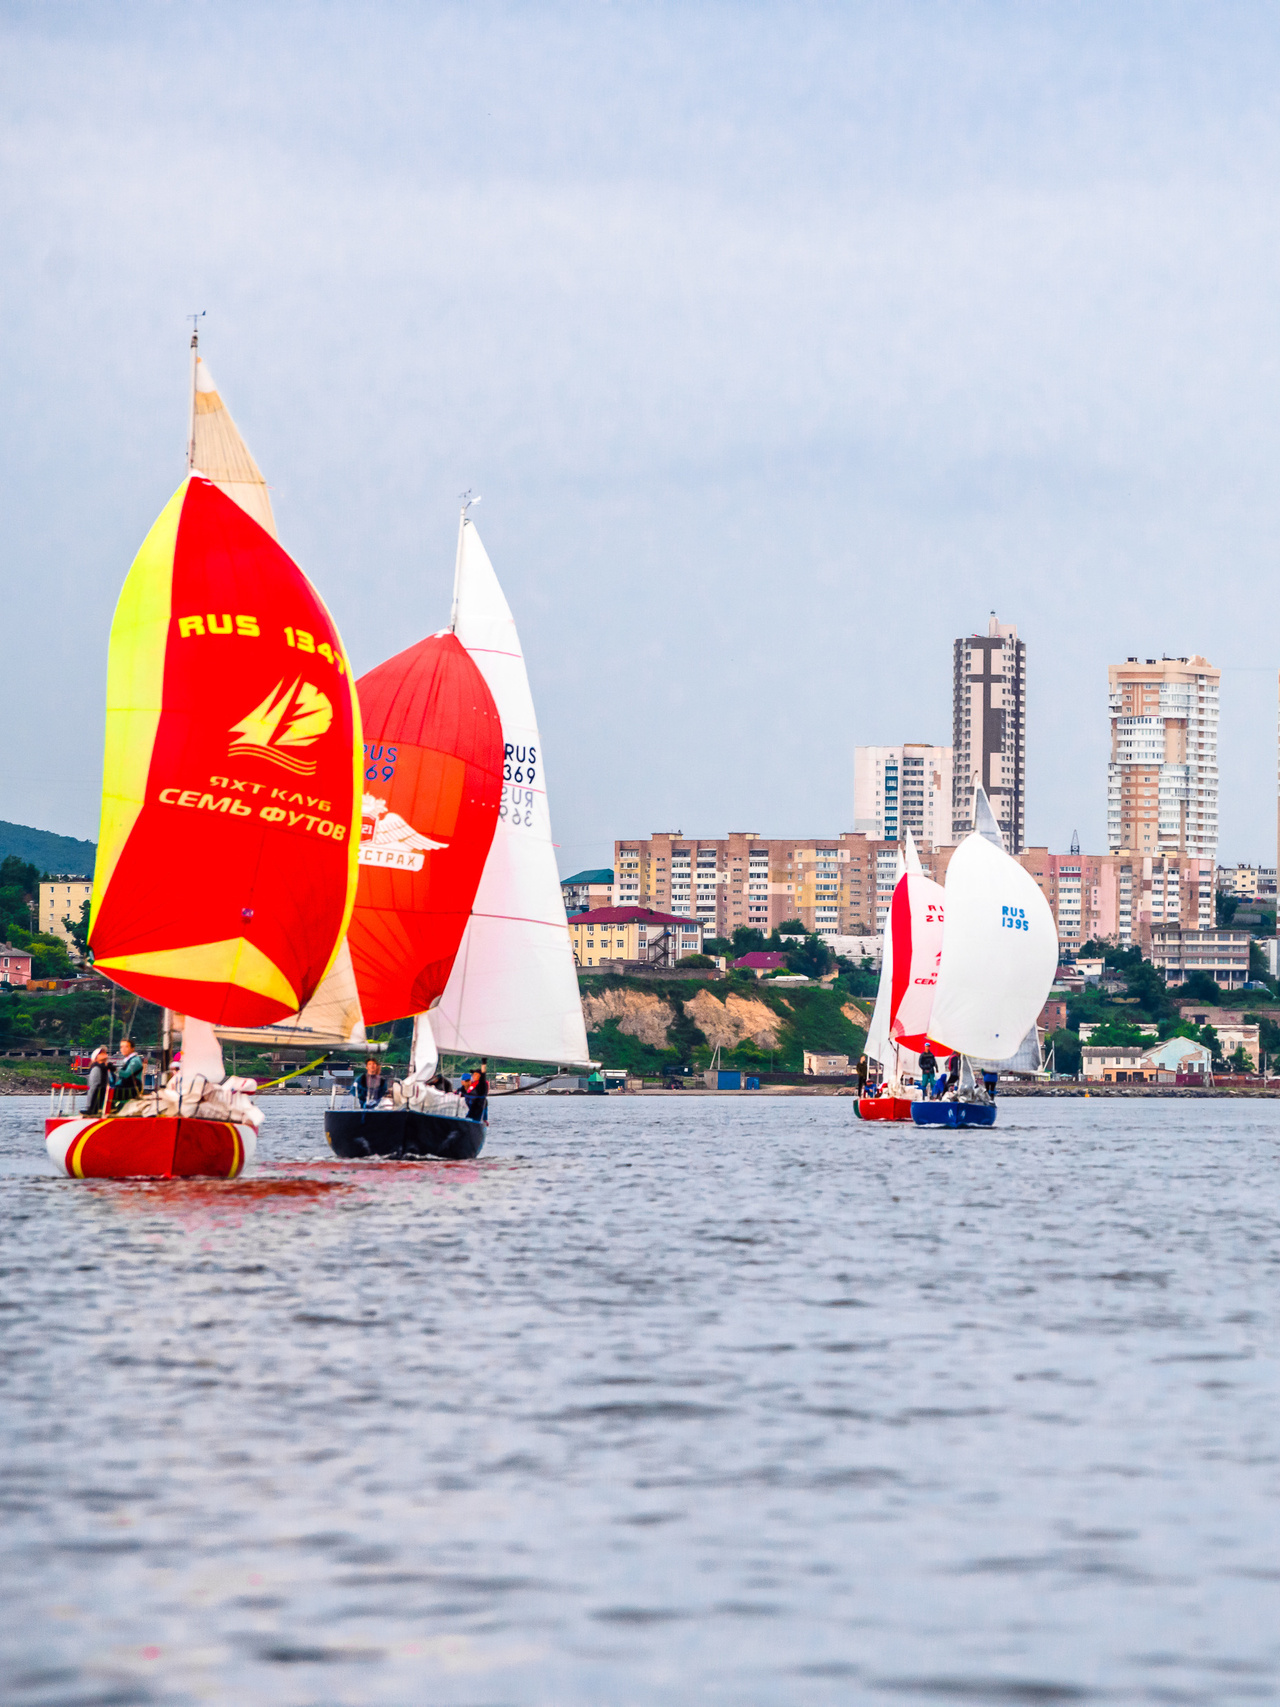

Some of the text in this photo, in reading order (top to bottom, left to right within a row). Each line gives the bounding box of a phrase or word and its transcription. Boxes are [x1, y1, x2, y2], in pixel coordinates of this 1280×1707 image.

[178, 613, 345, 675] RUS 1347
[504, 742, 536, 764] RUS
[209, 776, 332, 812] ЯХТ КЛУБ
[158, 788, 347, 841] СЕМЬ ФУТОВ
[359, 849, 416, 867] СТРАХ
[1001, 905, 1026, 919] RUS
[1001, 916, 1030, 931] 1395
